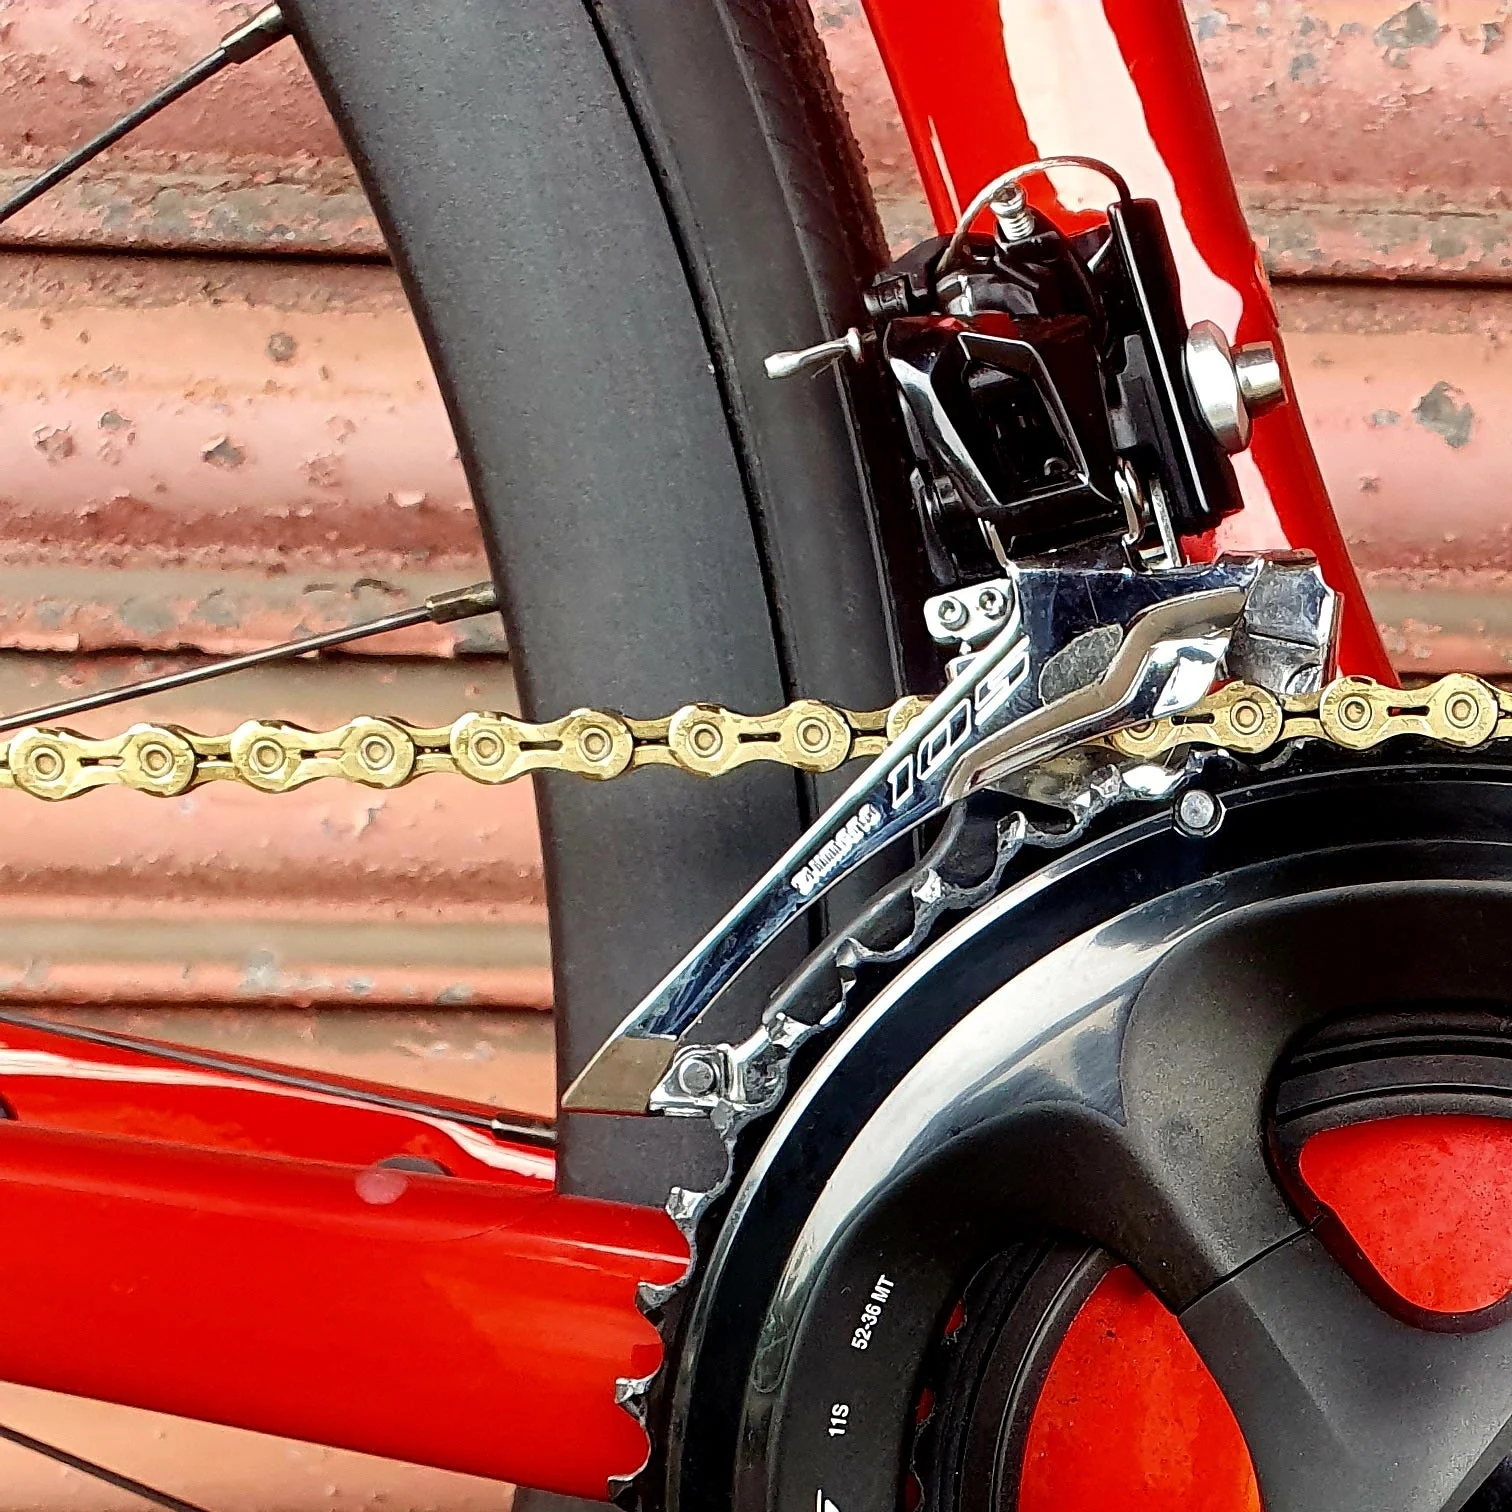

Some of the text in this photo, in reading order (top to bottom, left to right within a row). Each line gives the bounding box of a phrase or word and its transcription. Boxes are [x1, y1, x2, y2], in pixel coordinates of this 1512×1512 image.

[887, 635, 1030, 809] 105
[851, 1274, 895, 1350] 52-36 MT
[828, 1403, 850, 1437] 11S
